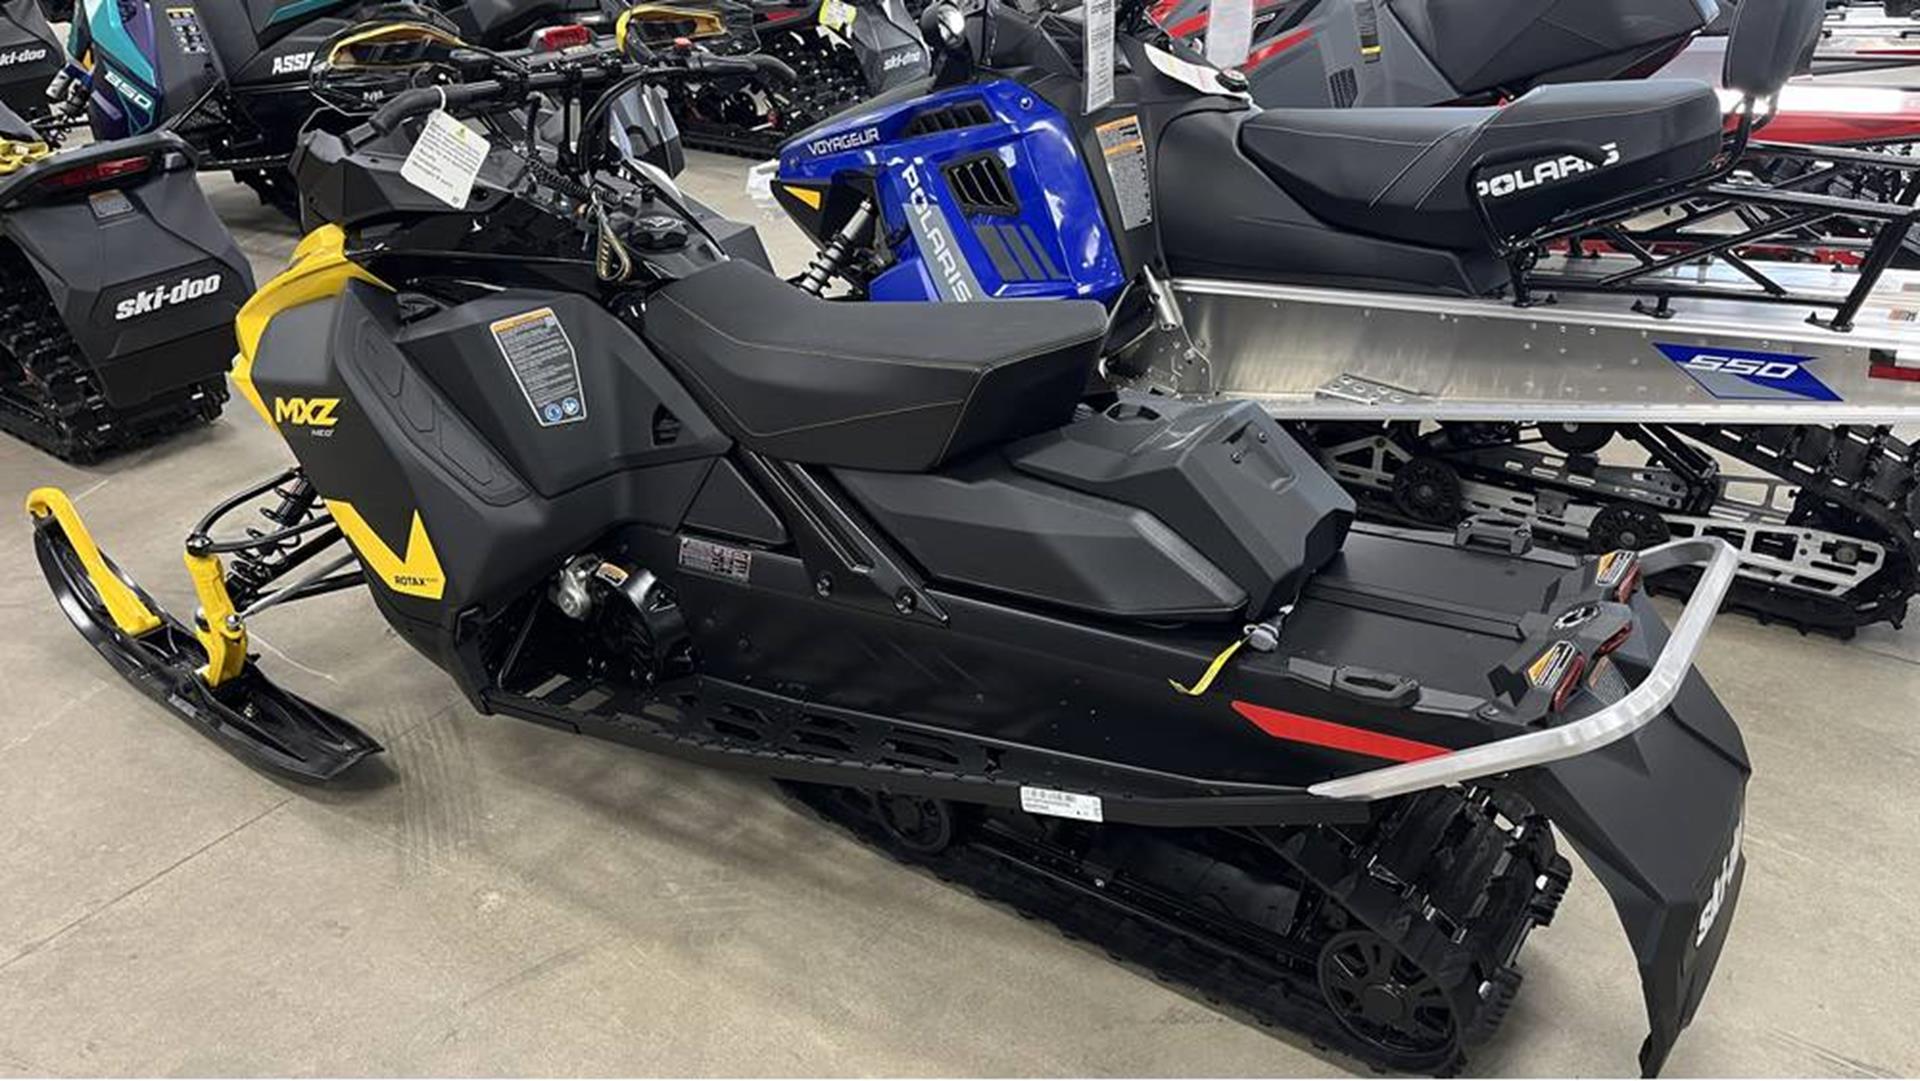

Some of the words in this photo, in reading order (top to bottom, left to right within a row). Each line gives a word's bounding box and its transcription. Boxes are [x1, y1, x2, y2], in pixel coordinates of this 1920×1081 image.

[0, 49, 47, 66] ki-doo
[104, 70, 152, 110] 850
[807, 127, 880, 156] VOYAGEUR
[902, 163, 973, 303] POLARIS
[115, 274, 221, 320] ski-doo
[1683, 354, 1799, 380] 550
[275, 397, 341, 426] MXZ
